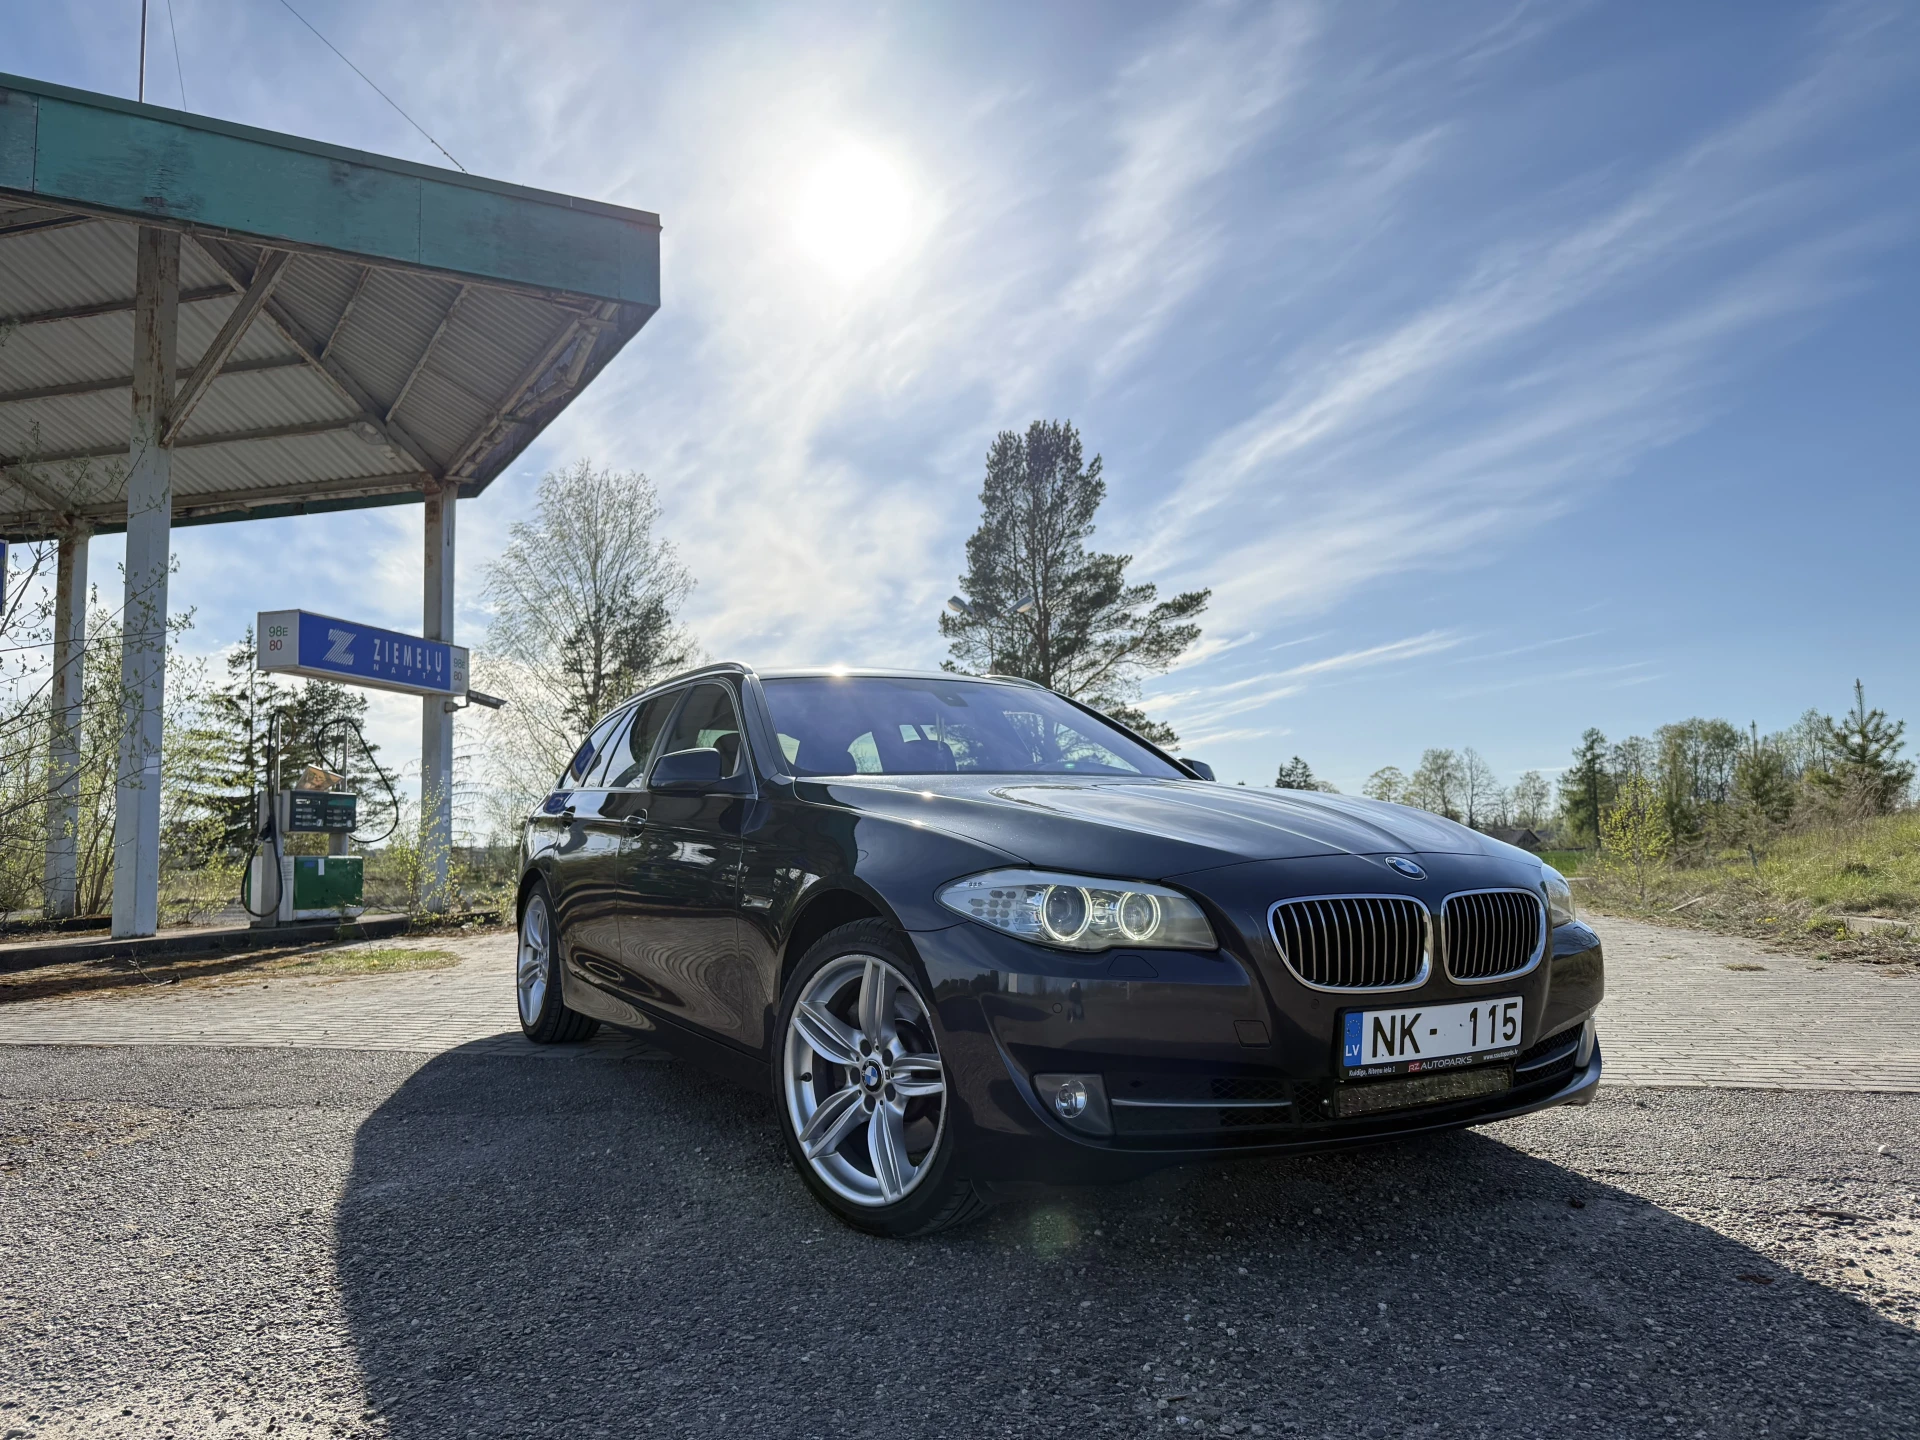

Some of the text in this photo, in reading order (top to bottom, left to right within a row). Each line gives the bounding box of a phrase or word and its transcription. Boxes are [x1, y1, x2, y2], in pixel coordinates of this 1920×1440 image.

[268, 625, 289, 638] 98E
[269, 639, 283, 651] 80
[373, 638, 442, 674] ZIEMEĻU
[373, 663, 442, 682] NAFTA
[453, 670, 463, 682] 80
[1469, 1002, 1518, 1047] 115
[1345, 1044, 1360, 1057] LV
[1420, 1055, 1473, 1070] AUTOPARKS
